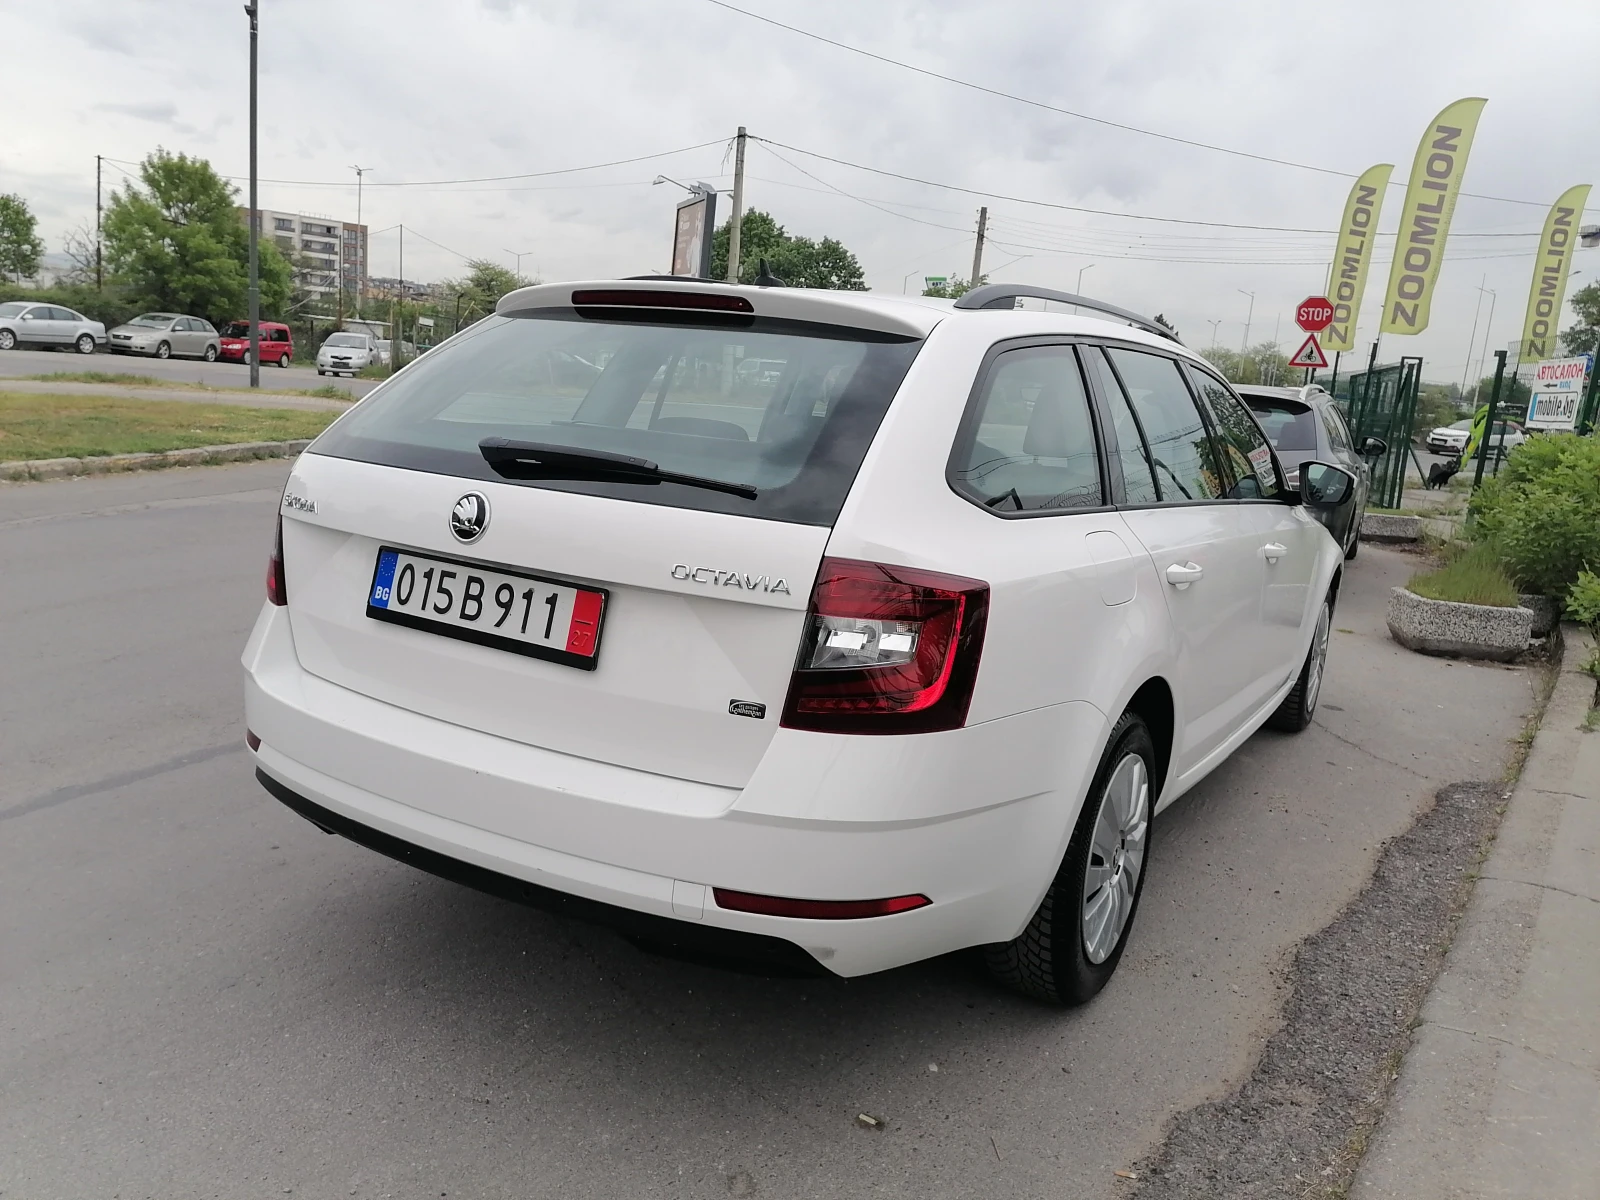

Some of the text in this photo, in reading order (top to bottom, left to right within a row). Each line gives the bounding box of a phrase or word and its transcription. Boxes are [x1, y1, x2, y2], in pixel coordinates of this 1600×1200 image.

[1391, 124, 1462, 327] ZOOMLION
[1327, 185, 1377, 344] ZOOMLION
[1527, 206, 1575, 358] ZOOMLION
[1299, 307, 1332, 322] STOP
[1536, 362, 1585, 380] АВТОСАЛОН
[1535, 395, 1576, 418] mobile.bg
[375, 585, 390, 601] BG
[671, 563, 791, 596] OCTAVIA
[396, 563, 559, 639] 015B911
[570, 630, 592, 647] 27
